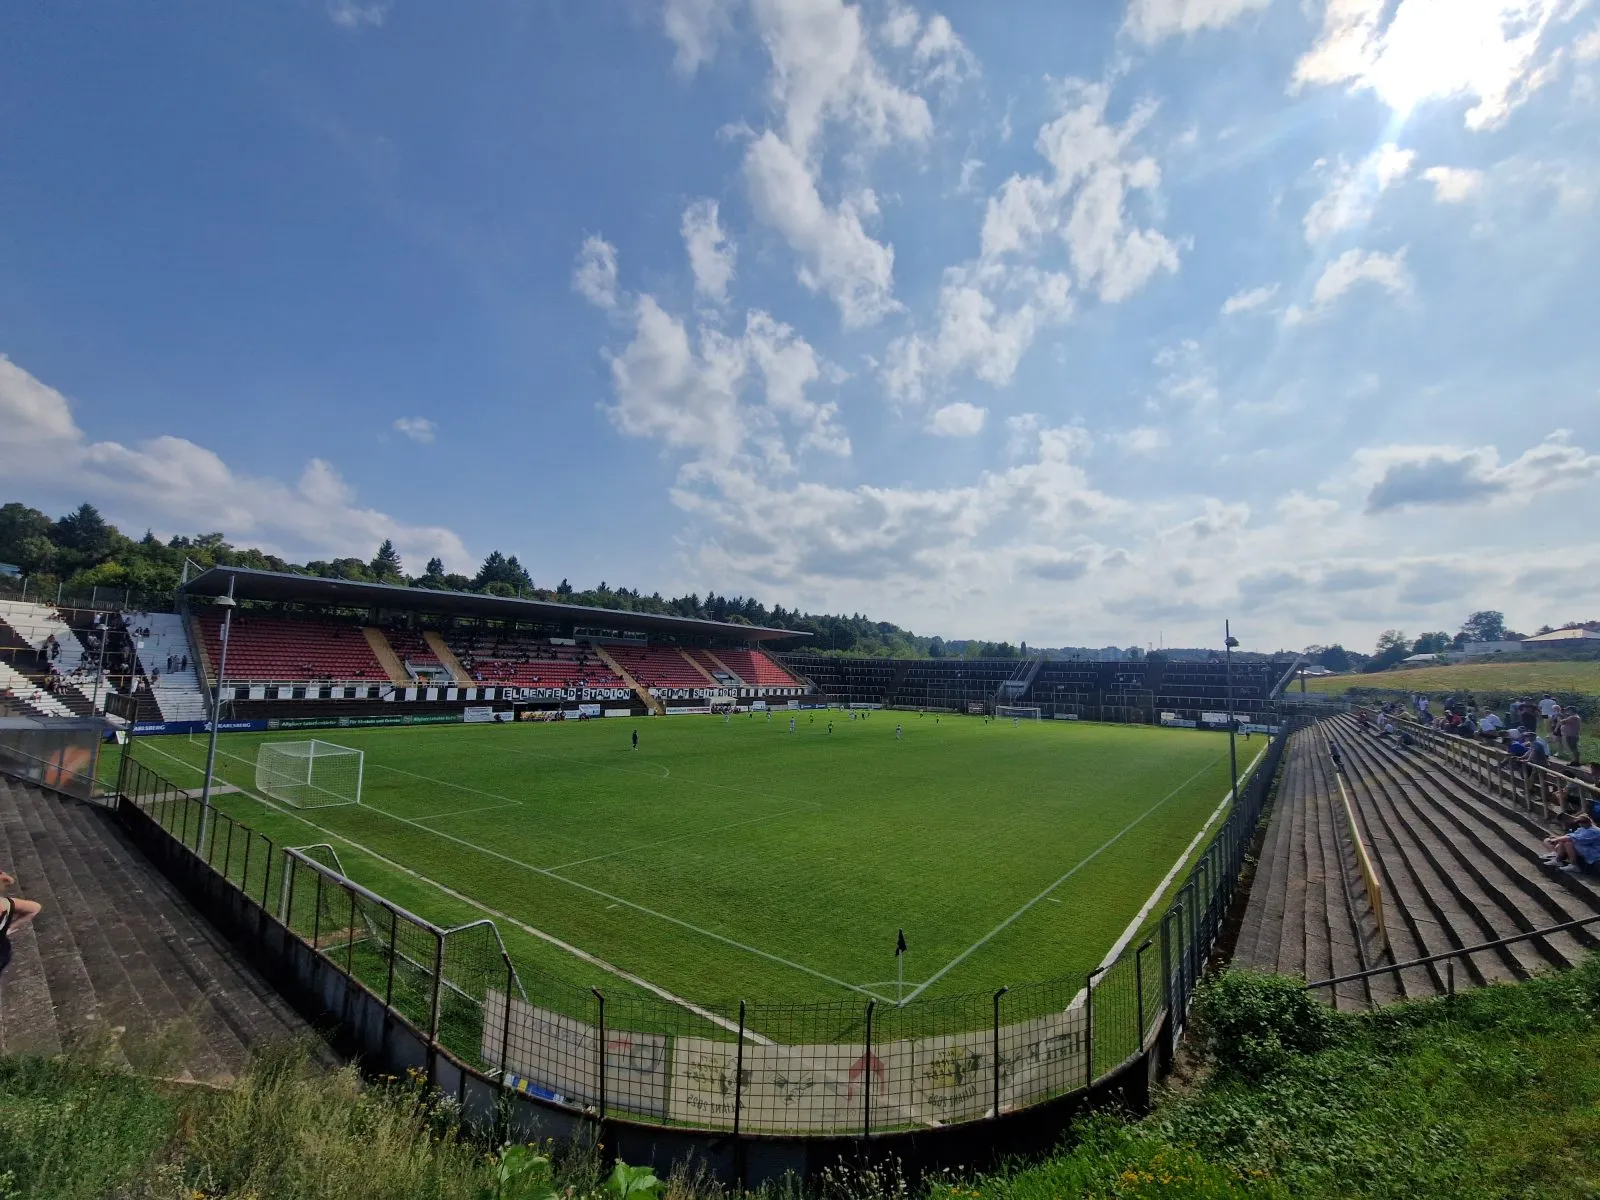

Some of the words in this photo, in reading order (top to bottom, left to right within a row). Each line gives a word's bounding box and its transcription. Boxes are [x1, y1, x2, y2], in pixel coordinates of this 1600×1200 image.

[503, 688, 631, 699] ELLENFELD-STADION
[656, 688, 689, 698] HEIMAT
[694, 689, 714, 697] SEIT
[133, 724, 166, 732] ARLSBERG
